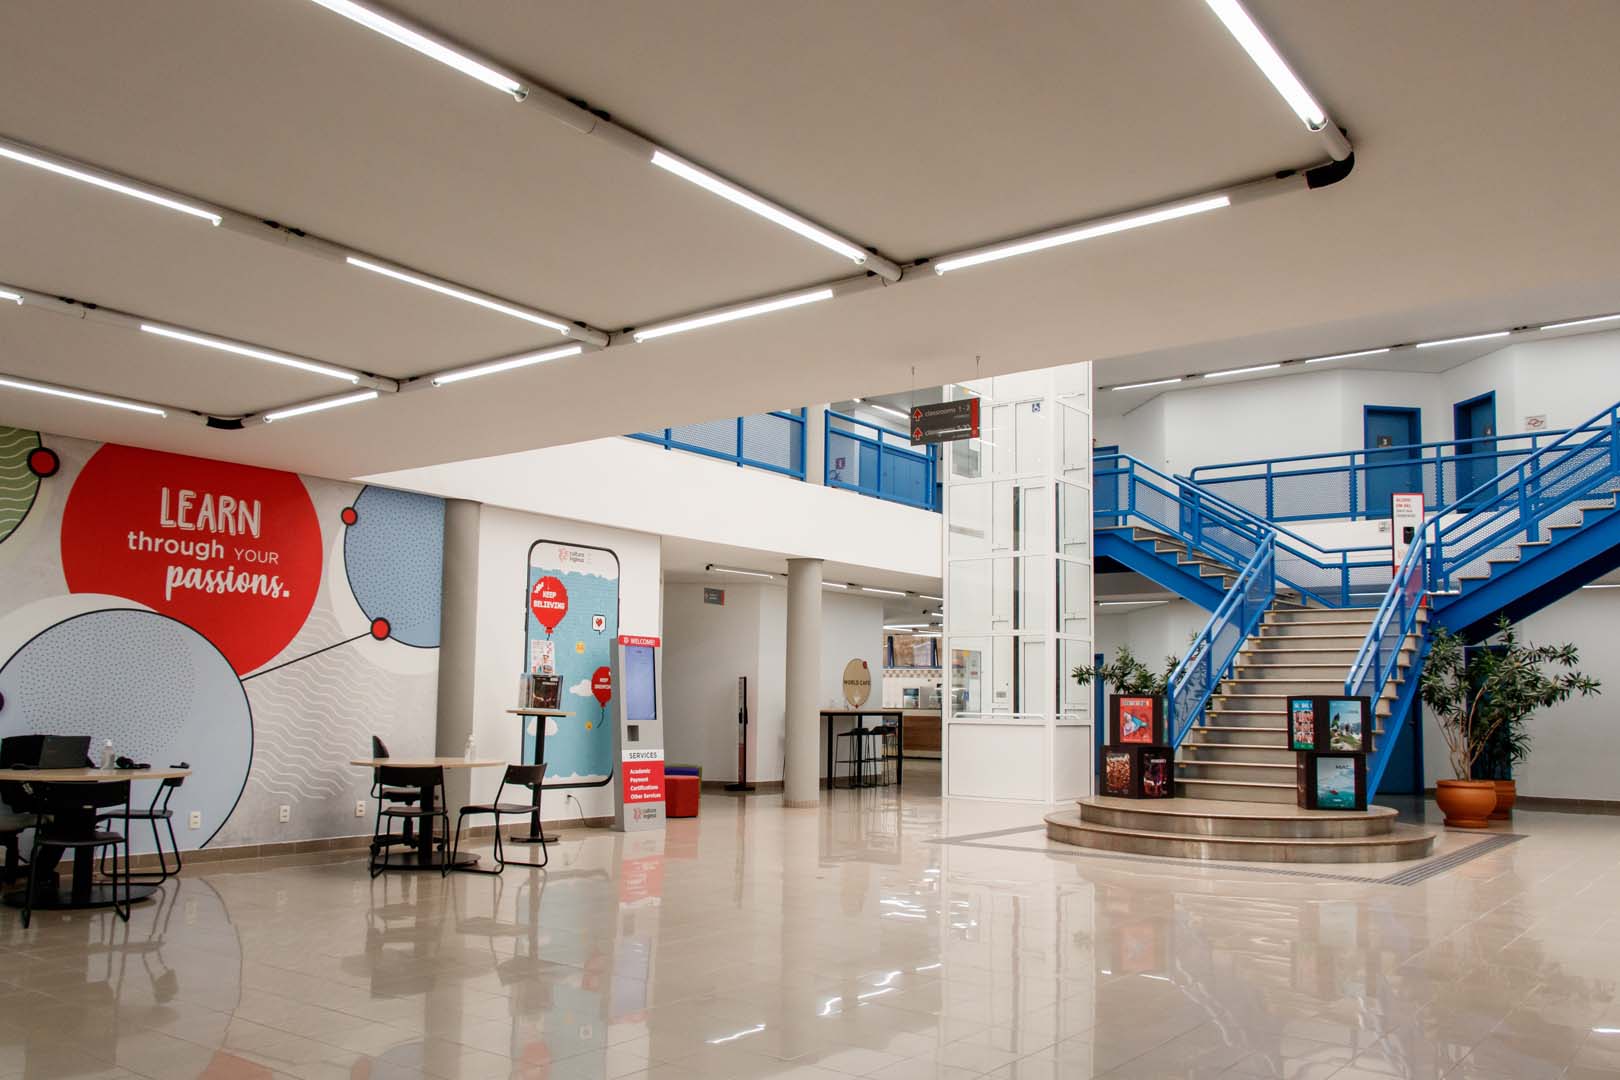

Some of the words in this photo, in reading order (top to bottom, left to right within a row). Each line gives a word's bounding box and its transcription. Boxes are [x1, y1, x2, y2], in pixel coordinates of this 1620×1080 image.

[160, 487, 261, 538] LEARN
[128, 531, 224, 560] through
[234, 548, 279, 565] YOUR
[165, 565, 290, 601] passions.
[533, 600, 565, 610] BELIEVING
